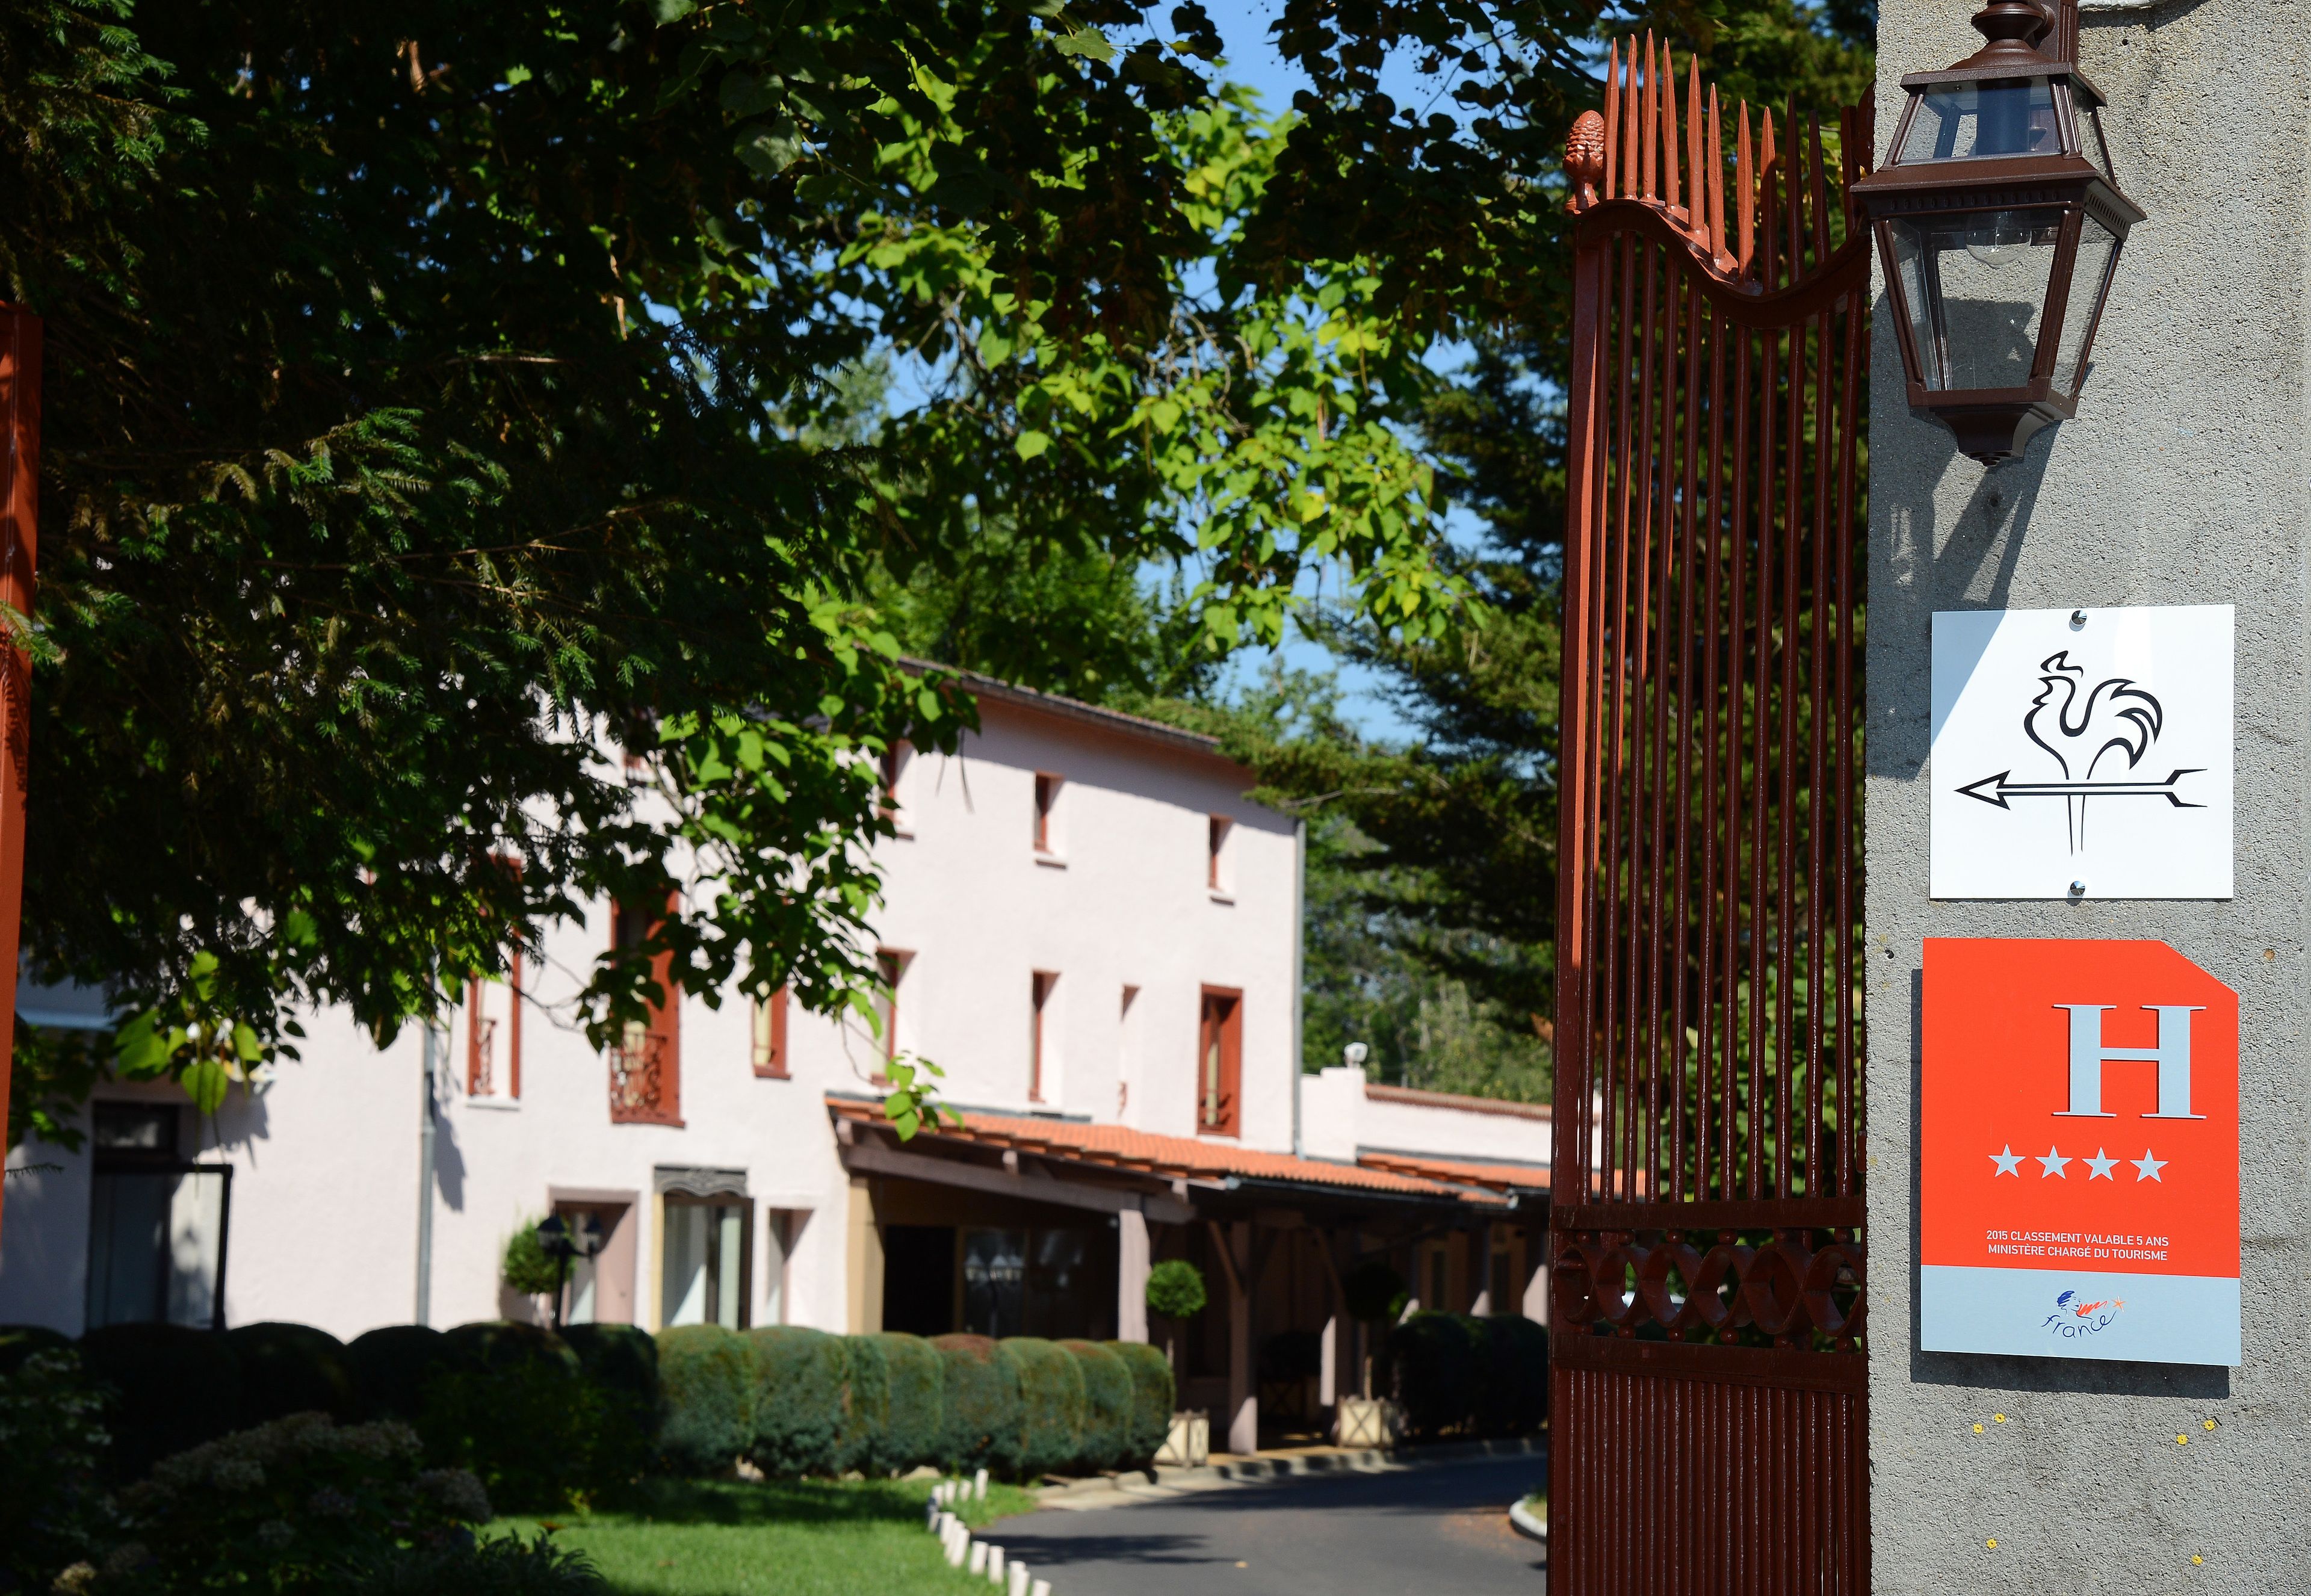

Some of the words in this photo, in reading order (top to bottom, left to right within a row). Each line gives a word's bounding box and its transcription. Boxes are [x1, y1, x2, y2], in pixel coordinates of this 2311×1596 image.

[2052, 1004, 2207, 1119] H
[1986, 1230, 2008, 1240] 2015
[2011, 1231, 2082, 1243] CLASSEMENT
[2084, 1234, 2134, 1245] VALABLE
[2136, 1236, 2143, 1246] 5
[2145, 1237, 2169, 1246] ANS
[1988, 1243, 2045, 1255] MINISTÈRE
[2047, 1246, 2091, 1257] CHARGÉ
[2094, 1249, 2109, 1258] DU
[2112, 1248, 2167, 1261] TOURISME
